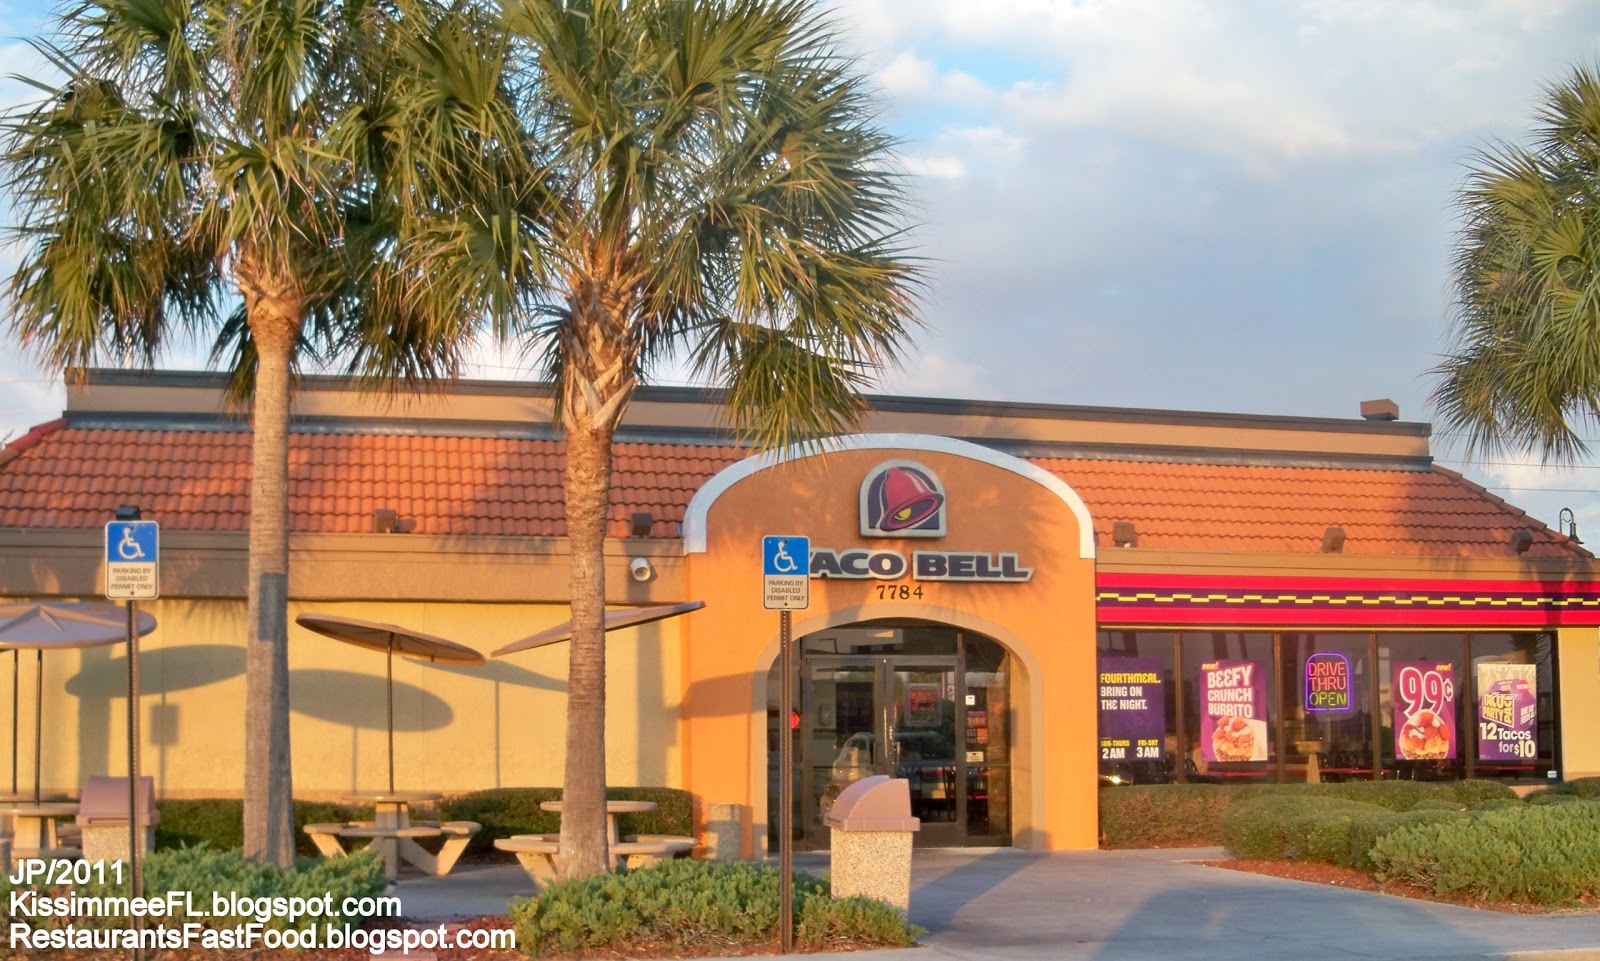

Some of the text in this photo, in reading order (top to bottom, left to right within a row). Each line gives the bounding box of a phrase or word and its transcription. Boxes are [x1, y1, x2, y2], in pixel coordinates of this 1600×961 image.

[809, 549, 1034, 582] ACO BELL
[876, 585, 923, 600] 7784
[1202, 661, 1219, 670] new!
[1308, 661, 1346, 676] DRIVE
[1436, 663, 1452, 671] new!
[1100, 673, 1161, 684] FOURTHMEAL.
[1207, 665, 1253, 688] BEEFY
[1308, 676, 1347, 691] THRU
[1101, 686, 1143, 697] BRING ON
[1207, 688, 1252, 702] CRUNCH
[1309, 691, 1347, 706] OPEN
[1101, 699, 1148, 710] THE NIGHT.
[1208, 703, 1253, 718] BURRITO
[1480, 722, 1531, 740] 12 Tacos
[1499, 740, 1536, 758] for $10
